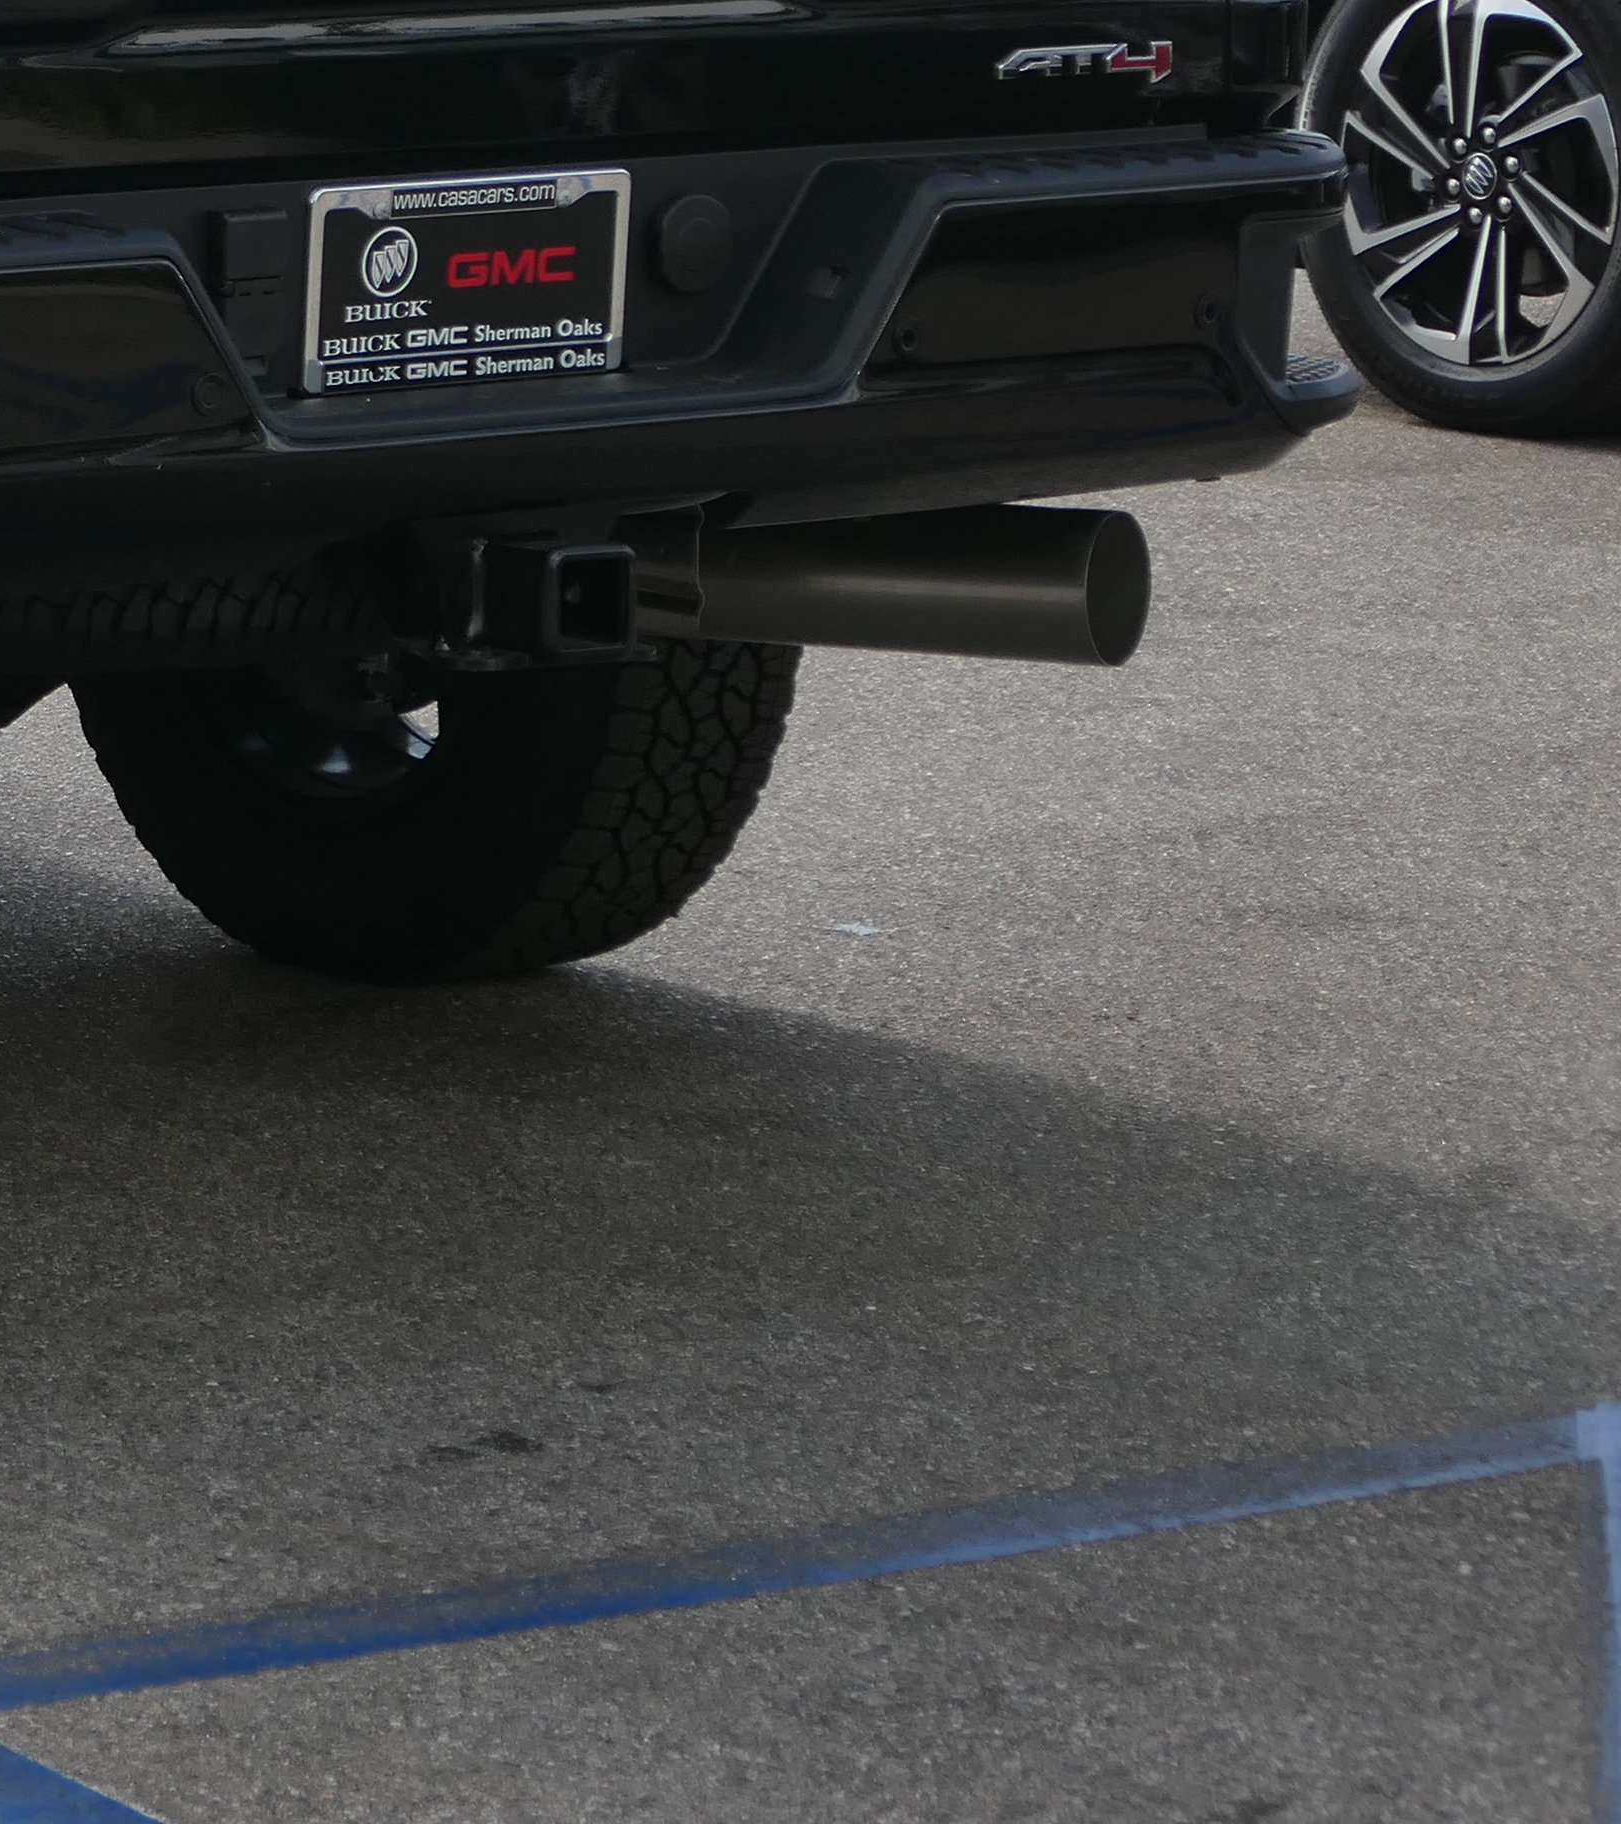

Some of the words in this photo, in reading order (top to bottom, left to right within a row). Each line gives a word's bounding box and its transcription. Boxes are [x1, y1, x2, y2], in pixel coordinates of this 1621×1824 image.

[996, 40, 1173, 84] AT4
[394, 183, 556, 209] www.casacars.com
[446, 245, 577, 289] GMC
[344, 299, 431, 323] BUICK
[323, 332, 401, 357] BUICK
[406, 325, 468, 347] GMC
[474, 319, 552, 343] Sherman
[558, 318, 604, 337] Oaks
[406, 359, 468, 380] GMC
[475, 354, 554, 376] Sherman
[560, 348, 606, 369] Oaks
